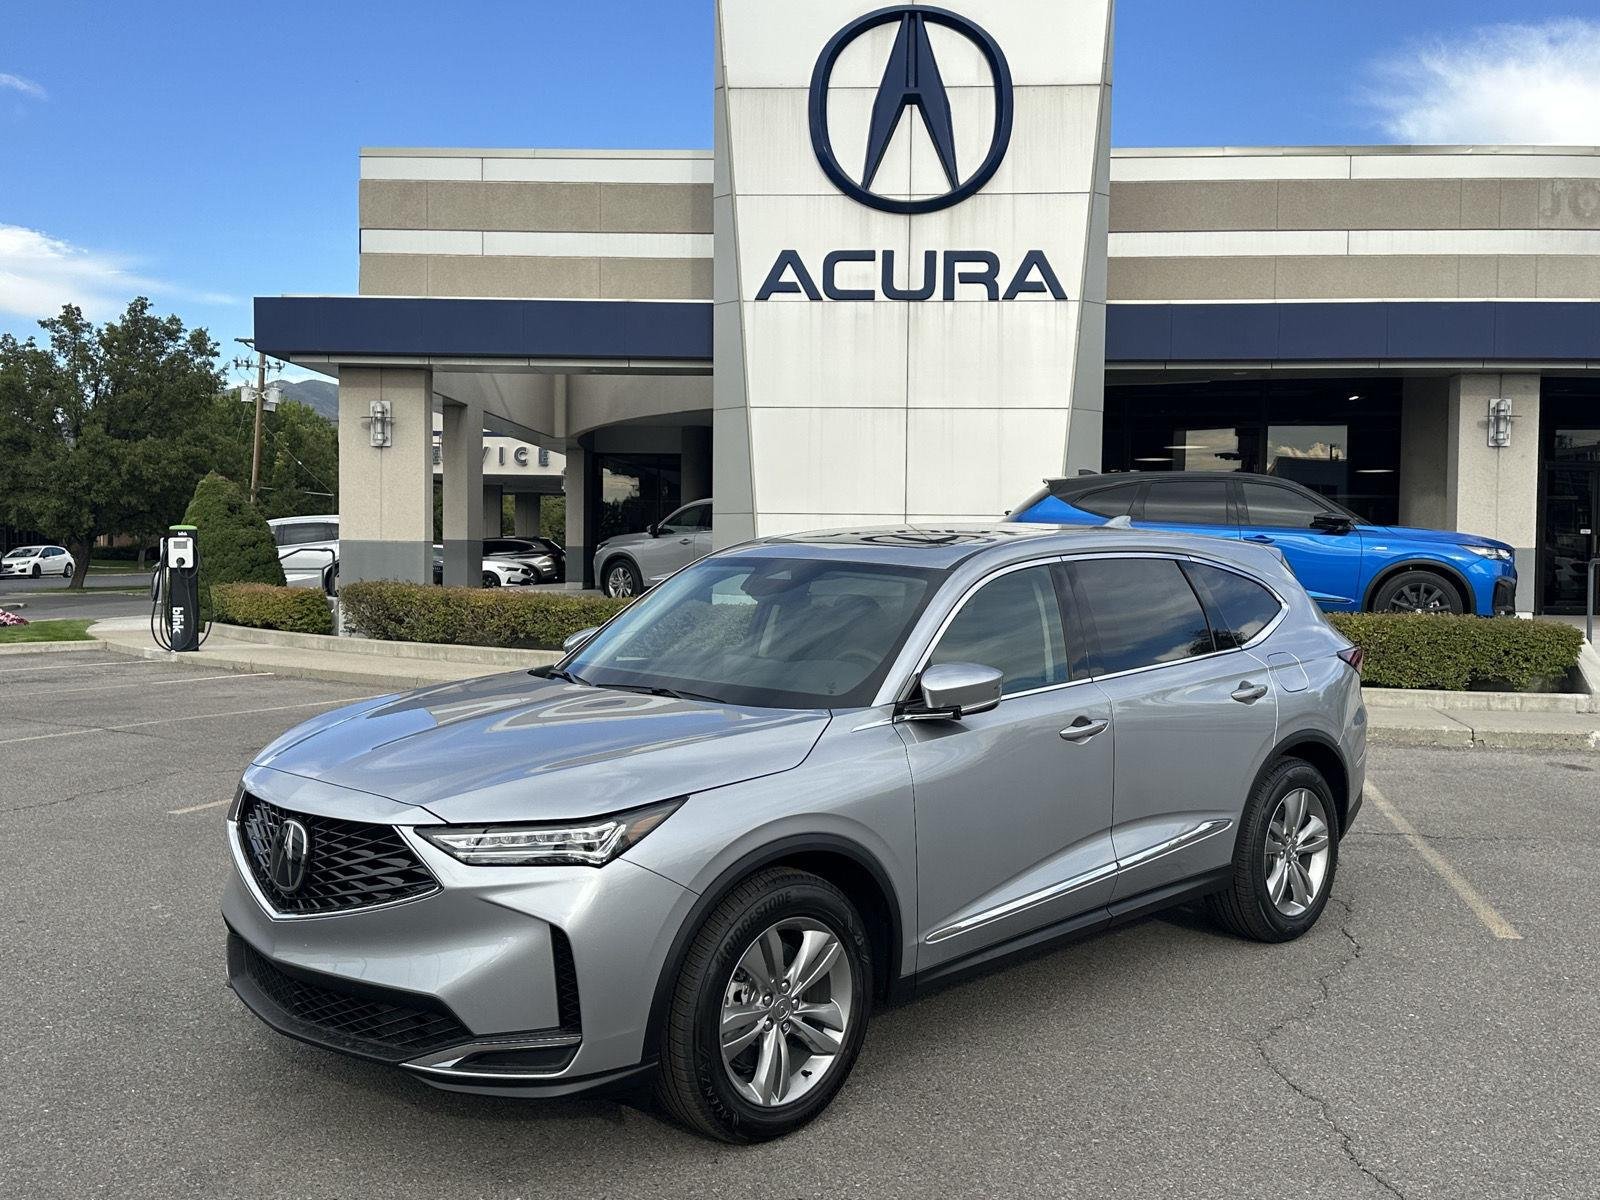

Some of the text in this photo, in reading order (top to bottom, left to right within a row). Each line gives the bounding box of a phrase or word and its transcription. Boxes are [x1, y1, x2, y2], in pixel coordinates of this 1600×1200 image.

[755, 249, 1068, 301] ACURA
[172, 606, 184, 634] blink
[716, 890, 793, 967] BRIDGESTONE
